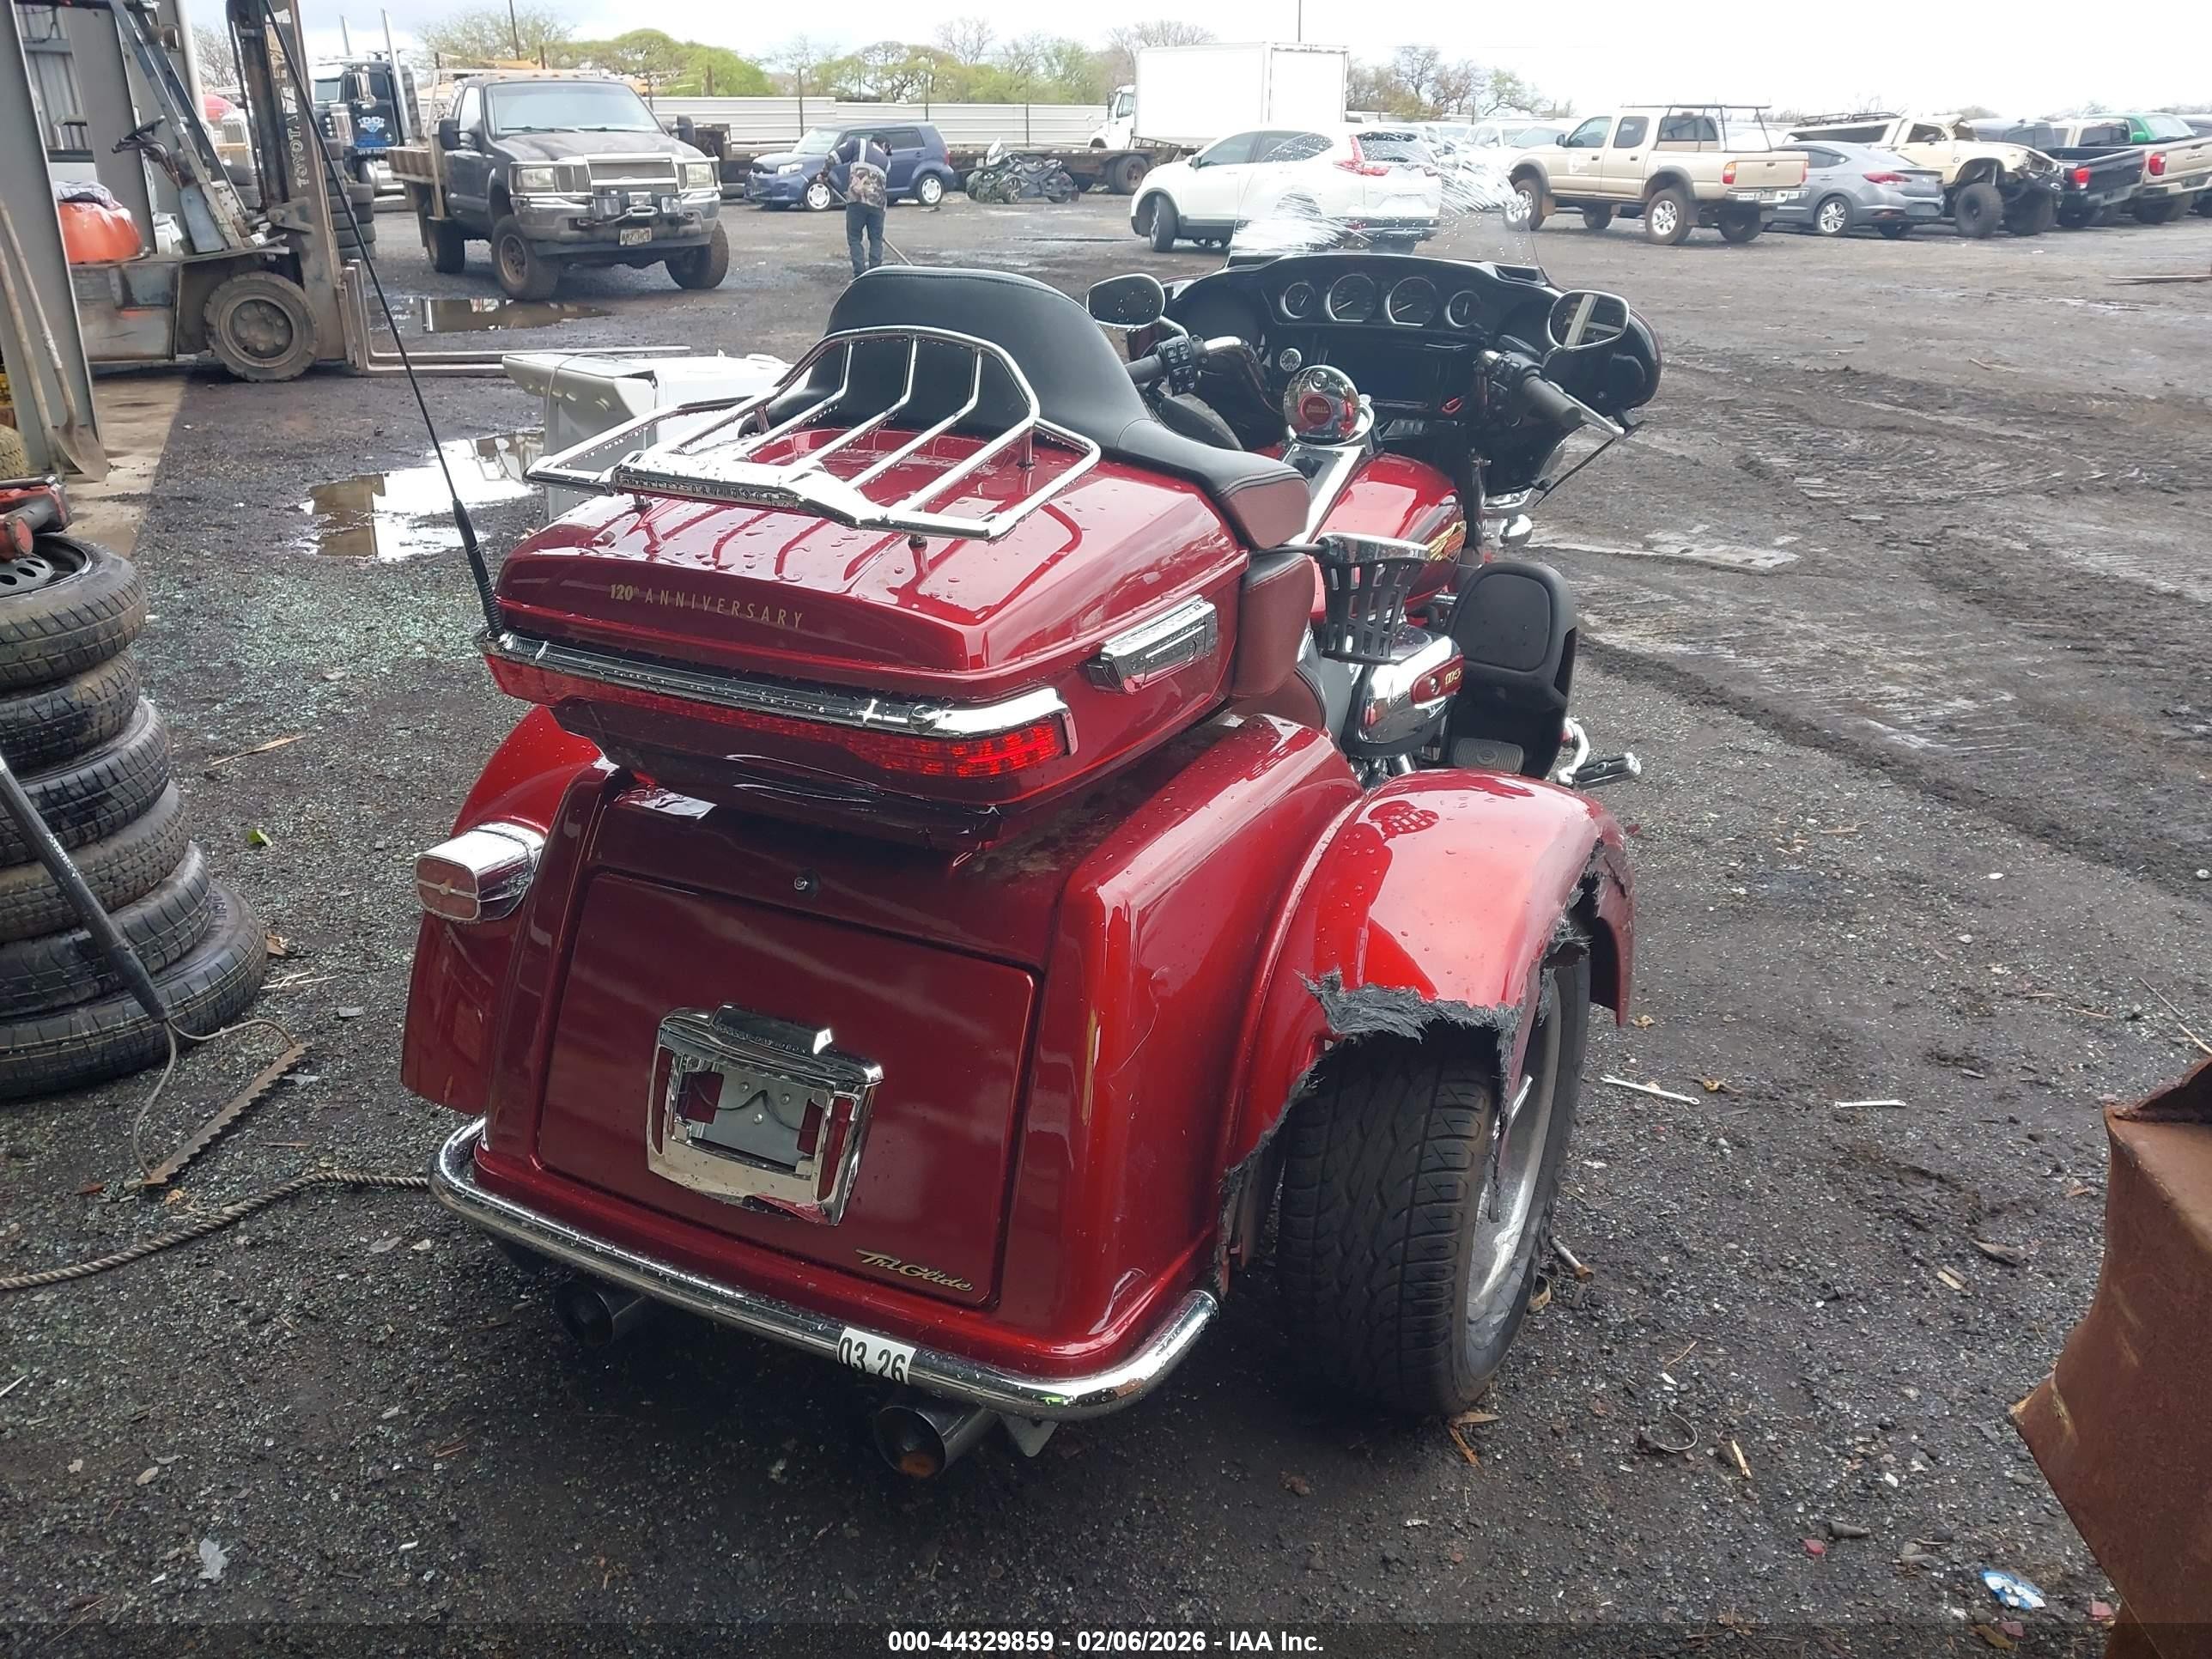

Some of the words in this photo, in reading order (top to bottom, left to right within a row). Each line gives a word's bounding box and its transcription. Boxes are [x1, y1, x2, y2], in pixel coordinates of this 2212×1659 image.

[646, 588, 804, 629] ANNIVERSARY
[838, 1337, 867, 1372] 03
[877, 1349, 906, 1384] 26
